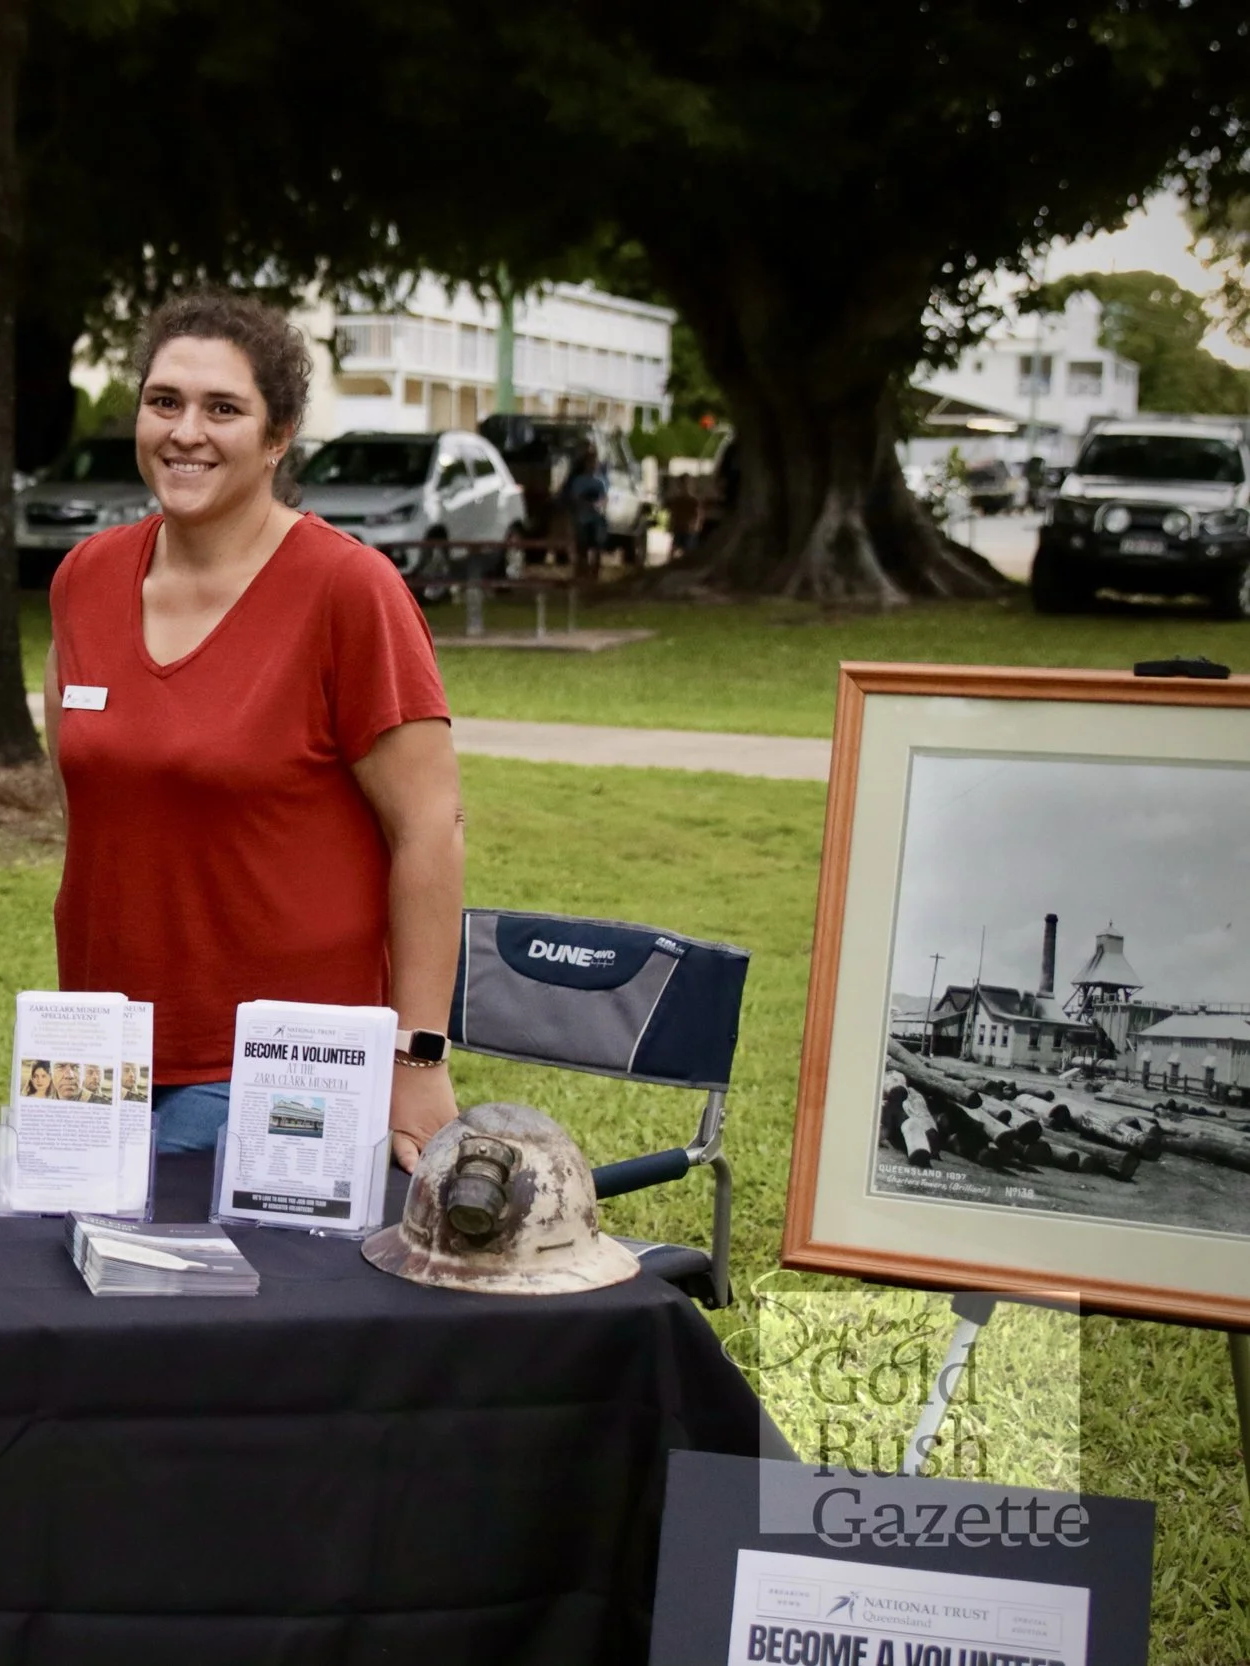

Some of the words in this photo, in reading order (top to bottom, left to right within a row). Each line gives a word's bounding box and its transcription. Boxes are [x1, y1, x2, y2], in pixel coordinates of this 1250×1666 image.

[528, 939, 594, 967] DUNE
[244, 1041, 289, 1060] BECOME
[291, 1045, 299, 1061] A
[302, 1045, 366, 1066] VOLUNTEER
[253, 1073, 275, 1084] ZARA
[278, 1075, 305, 1087] CLARK
[878, 1163, 942, 1178] QUEENSLAND
[862, 1612, 933, 1629] Queensland
[863, 1596, 940, 1617] NATIONAL
[943, 1605, 990, 1621] TRUST
[747, 1624, 868, 1666] BECOME
[876, 1639, 896, 1666] A
